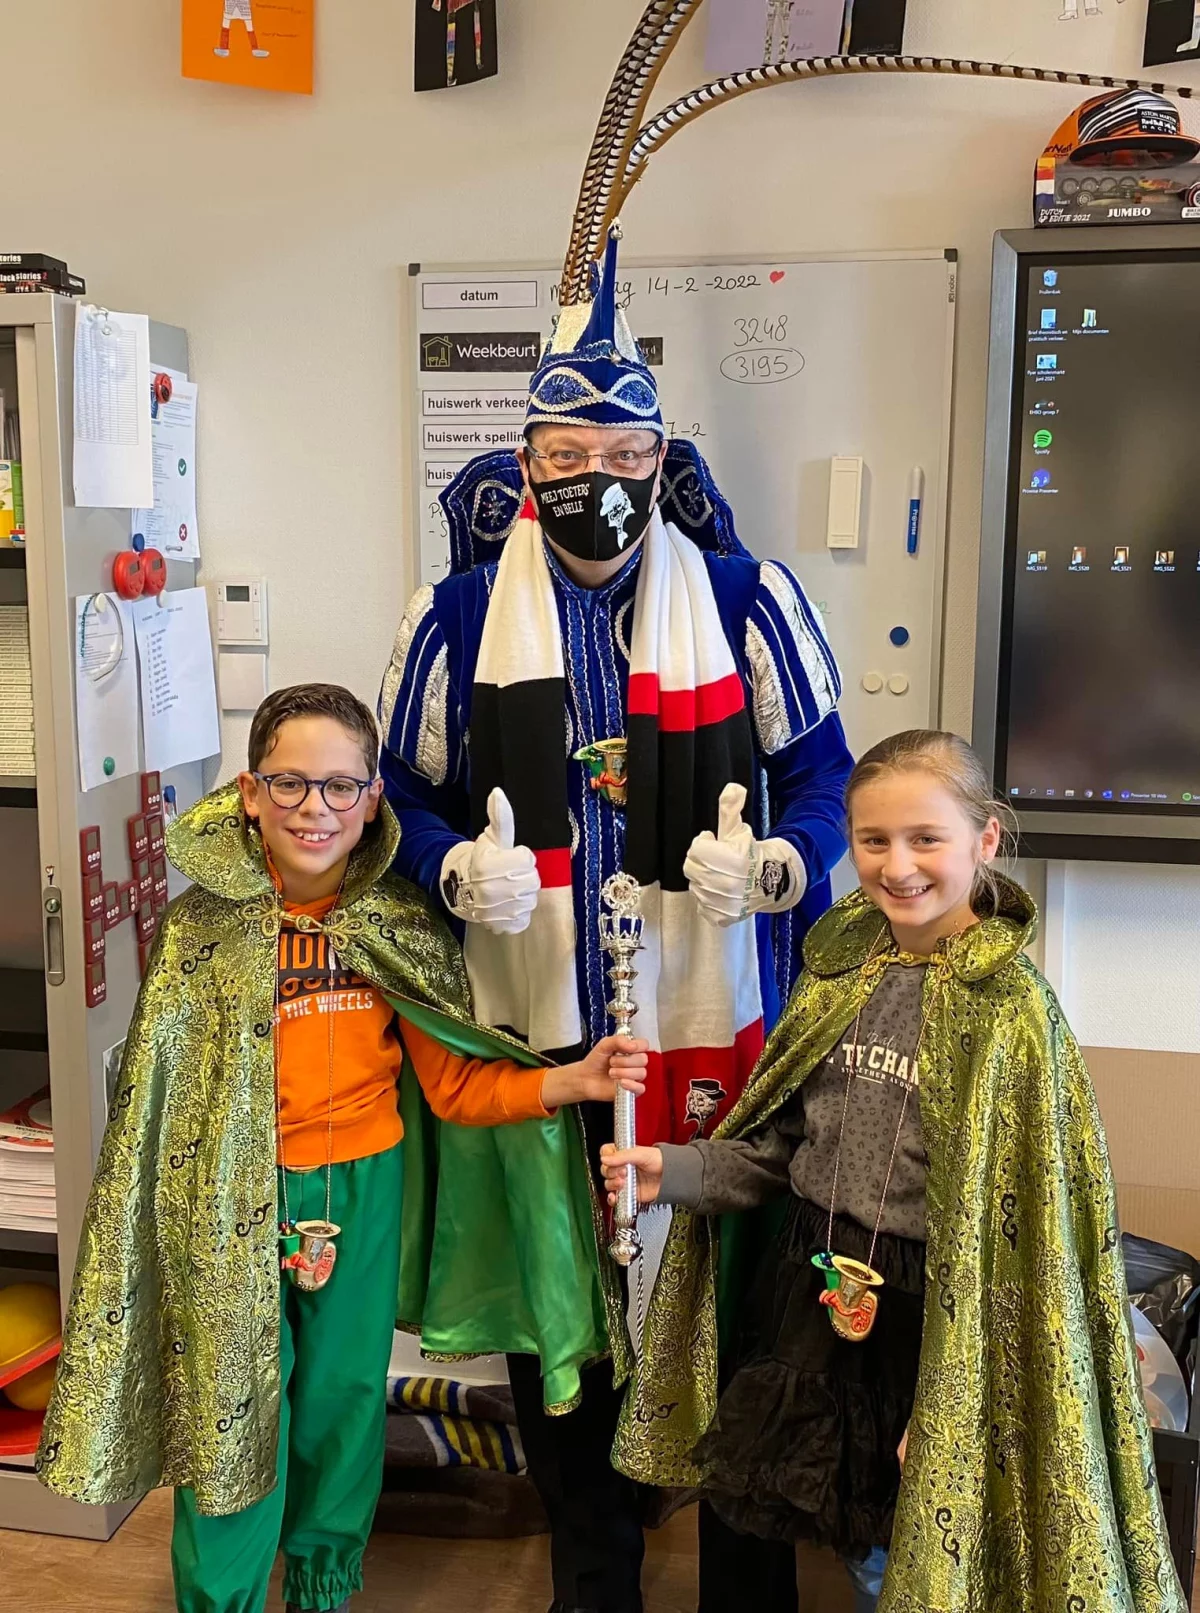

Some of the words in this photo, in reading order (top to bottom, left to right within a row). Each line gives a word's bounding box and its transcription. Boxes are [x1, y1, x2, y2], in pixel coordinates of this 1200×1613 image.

[1040, 208, 1064, 216] DUTCH
[1049, 214, 1071, 222] EDITIE
[1072, 213, 1091, 221] 2021
[1107, 207, 1151, 218] JUMBO
[0, 254, 22, 262] tories
[0, 274, 16, 282] lack
[15, 272, 42, 280] stories
[460, 289, 499, 302] datum
[733, 314, 789, 347] 3248
[457, 342, 537, 358] Weekbeurt
[735, 354, 789, 378] 3195
[428, 398, 482, 409] huiswerk
[427, 431, 481, 442] huiswerk
[540, 490, 558, 504] MEEJ
[559, 483, 590, 500] TOETERS
[552, 505, 566, 518] EN
[564, 501, 585, 515] BELLE
[284, 998, 312, 1019] THE
[316, 992, 374, 1014] WHEELS
